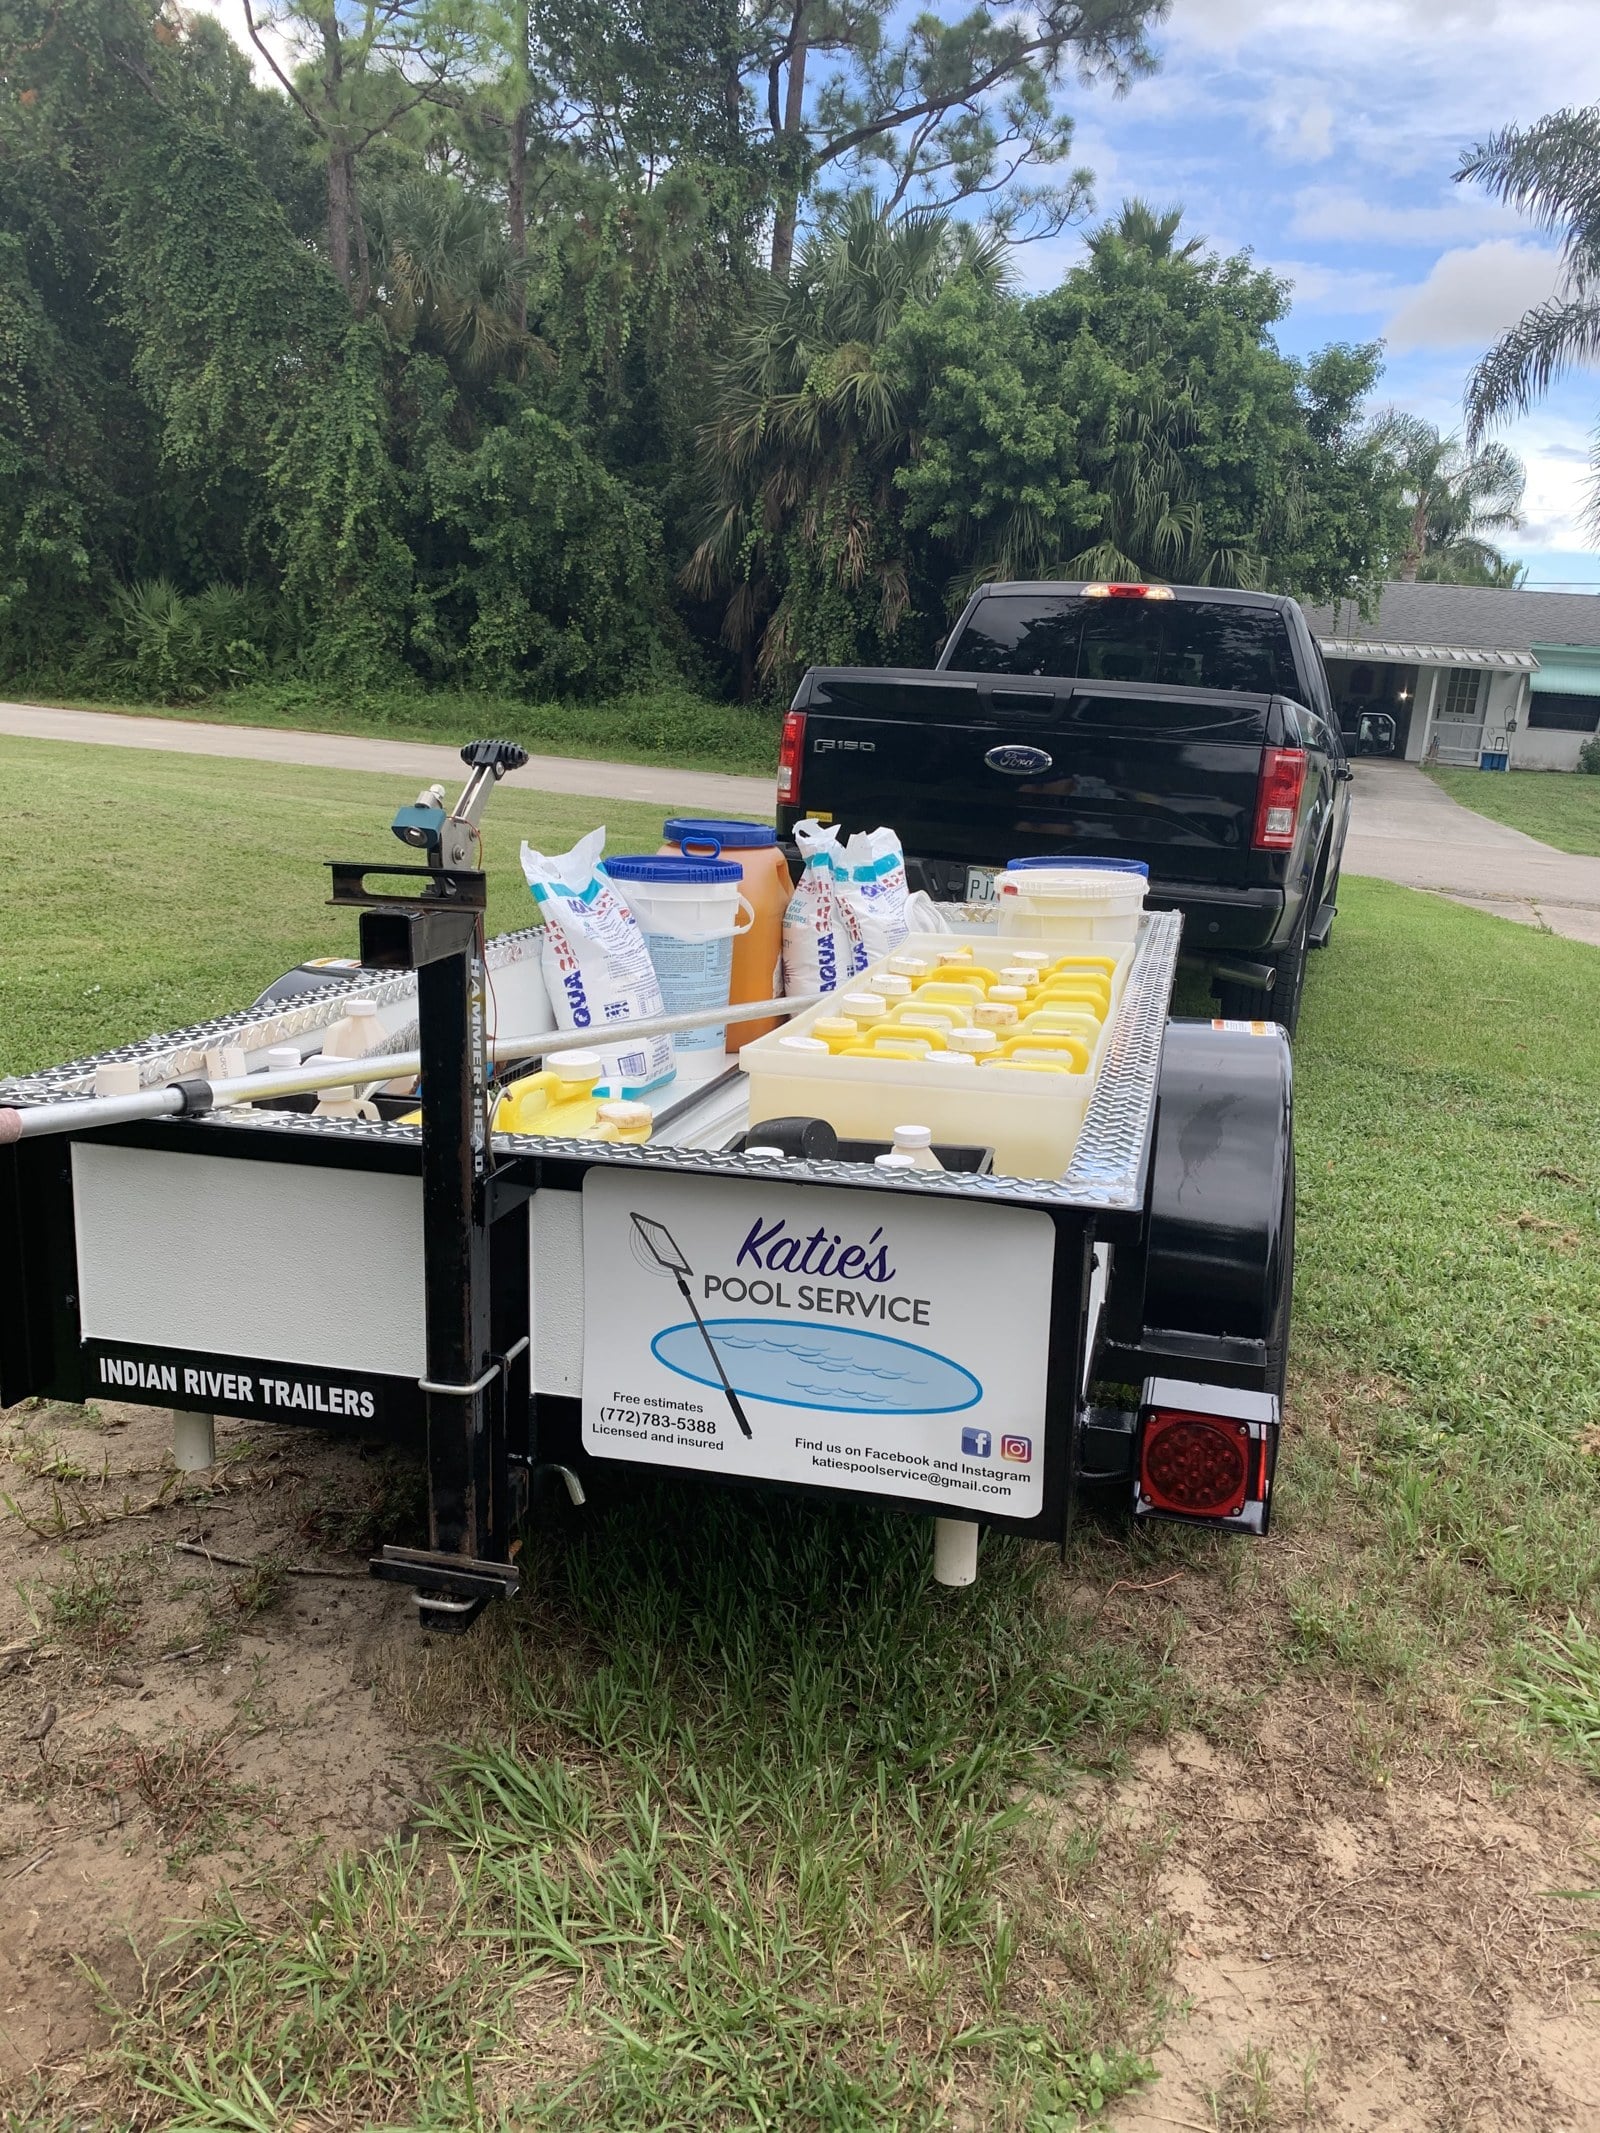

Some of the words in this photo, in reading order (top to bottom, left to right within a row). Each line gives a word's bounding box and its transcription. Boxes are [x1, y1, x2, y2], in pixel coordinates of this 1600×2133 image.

[999, 750, 1036, 769] Ford
[563, 969, 592, 1028] QUA
[736, 1216, 896, 1283] Katie's
[704, 1274, 791, 1308] POOL
[797, 1285, 931, 1326] SERVICE
[100, 1357, 177, 1392] INDIAN
[184, 1368, 254, 1402] RIVER
[259, 1378, 375, 1418] TRAILERS
[613, 1391, 641, 1405] Free
[643, 1396, 704, 1413] estimates
[592, 1423, 648, 1440] Licensed
[651, 1431, 674, 1444] and
[677, 1434, 724, 1451] insured
[600, 1407, 716, 1435] (772)783-5388
[795, 1437, 823, 1452] Find
[826, 1443, 842, 1455] us
[845, 1446, 861, 1458] on
[865, 1447, 930, 1467] Facebook
[933, 1457, 958, 1473] and
[961, 1463, 1031, 1484] Instagram
[812, 1455, 1012, 1497] katiespoolservice@gmail.com
